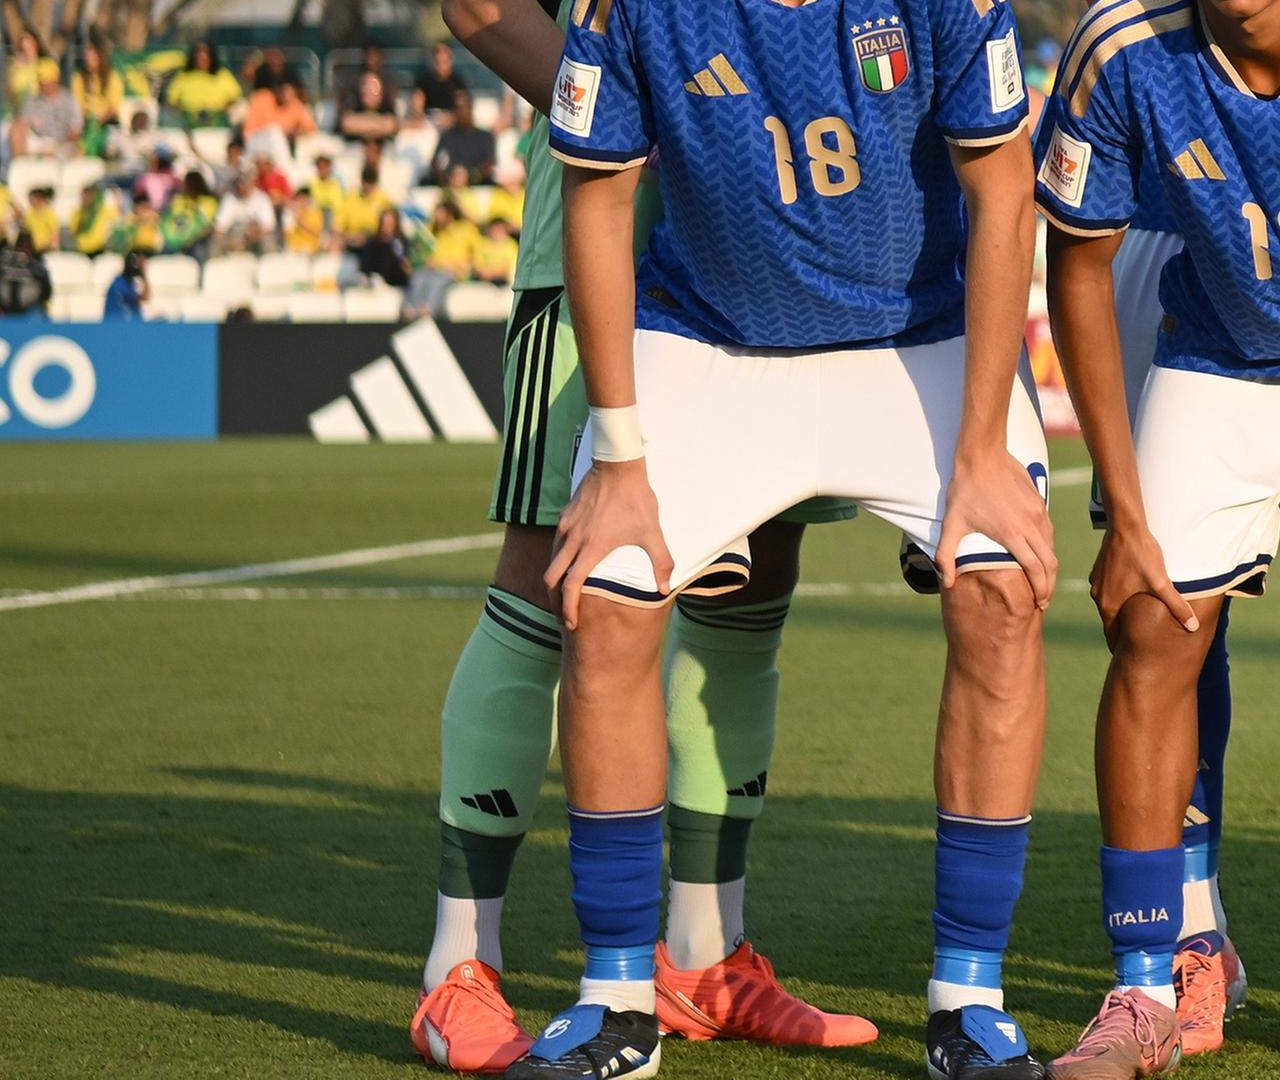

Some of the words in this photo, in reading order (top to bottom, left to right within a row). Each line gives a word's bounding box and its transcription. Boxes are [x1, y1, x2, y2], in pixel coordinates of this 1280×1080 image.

[857, 33, 901, 55] ITALIA
[763, 116, 861, 205] 18
[1109, 907, 1169, 928] ITALIA
